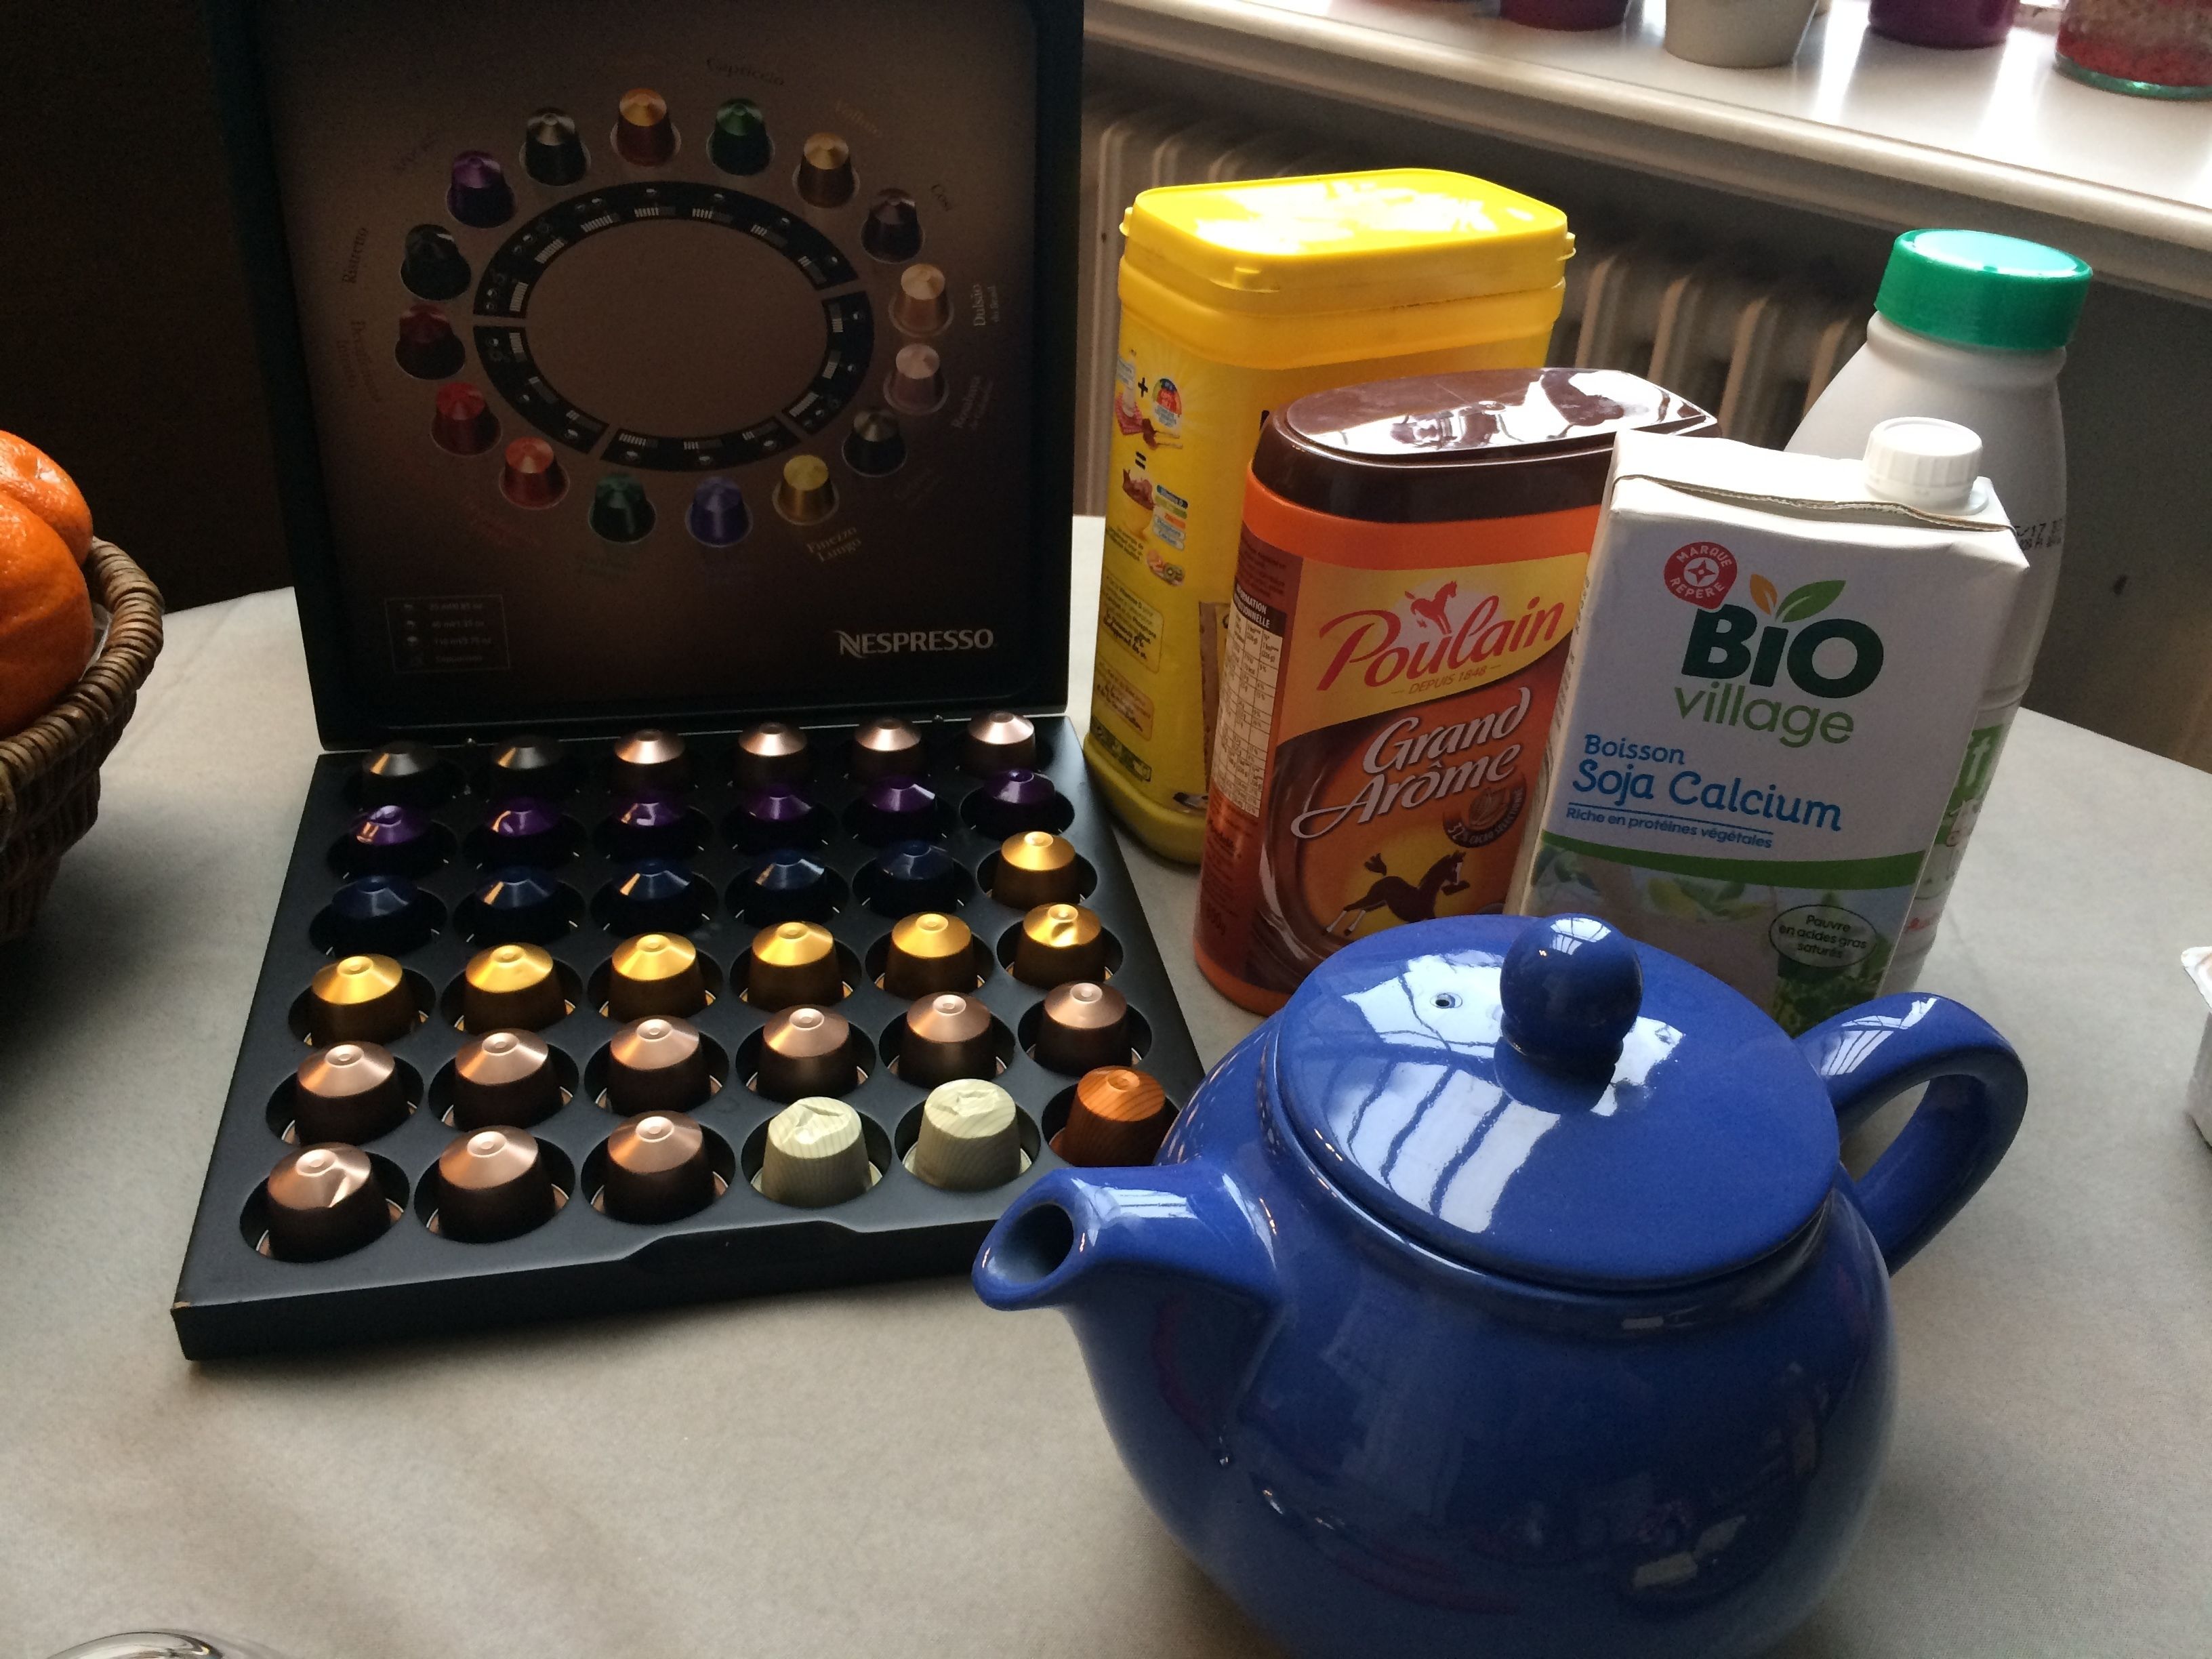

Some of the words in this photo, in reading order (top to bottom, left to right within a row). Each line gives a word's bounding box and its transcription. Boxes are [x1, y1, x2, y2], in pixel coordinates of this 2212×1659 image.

[1676, 545, 1733, 568] MARQUE
[834, 628, 994, 659] NESPRESSO
[1317, 594, 1565, 691] Poulain
[1408, 674, 1455, 695] DEPUIS
[1458, 665, 1488, 682] 1848
[1362, 686, 1532, 775] Grand
[1674, 680, 1855, 748] village
[1583, 733, 1685, 766] Boisson
[1290, 743, 1521, 839] Arôme
[1572, 758, 1654, 808] Soja
[1668, 771, 1843, 832] Calcium
[1566, 806, 1605, 824] Riche
[1607, 814, 1626, 826] en
[1628, 816, 1698, 836] protéines
[1701, 828, 1774, 849] végétales
[1778, 923, 1795, 937] en
[1797, 927, 1837, 944] acides
[1838, 937, 1868, 949] gras
[1805, 914, 1851, 933] Pauvre
[1797, 942, 1845, 959] saturés
